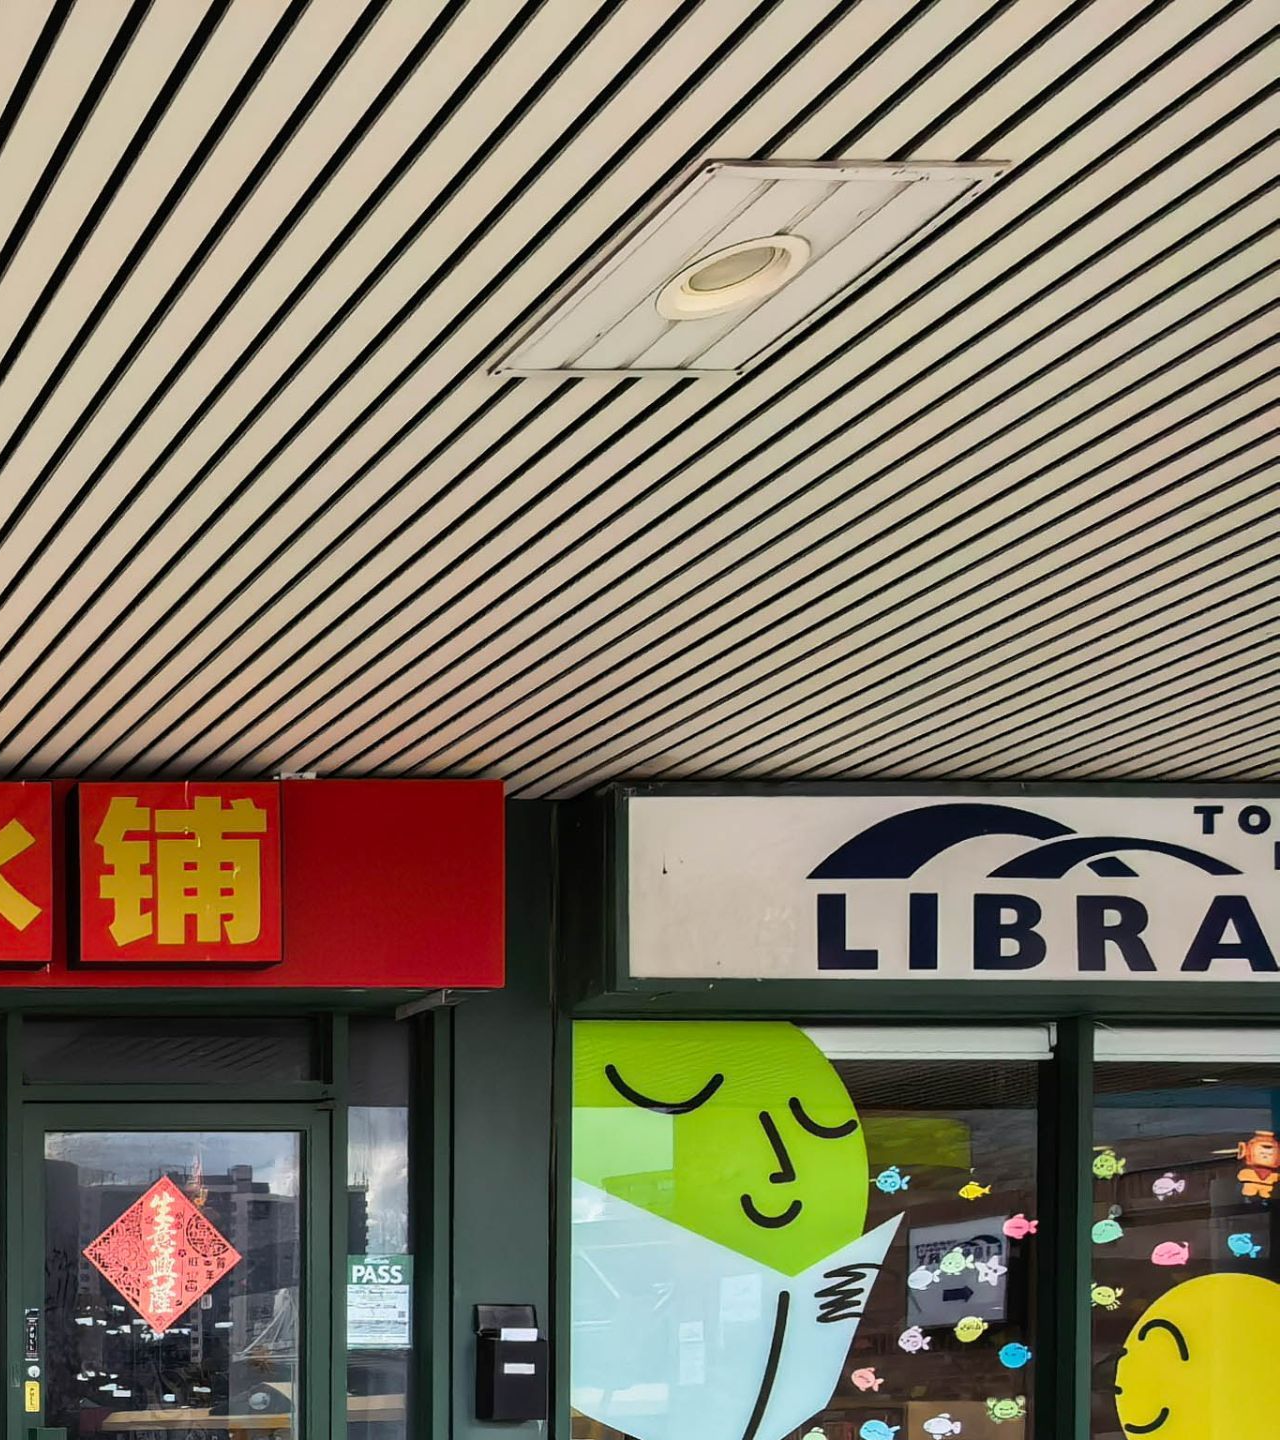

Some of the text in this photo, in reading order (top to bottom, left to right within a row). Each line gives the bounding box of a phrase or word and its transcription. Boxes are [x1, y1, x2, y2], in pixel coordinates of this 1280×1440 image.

[1194, 805, 1271, 834] TO
[817, 893, 1280, 972] LIBRA
[352, 1265, 403, 1284] PASS
